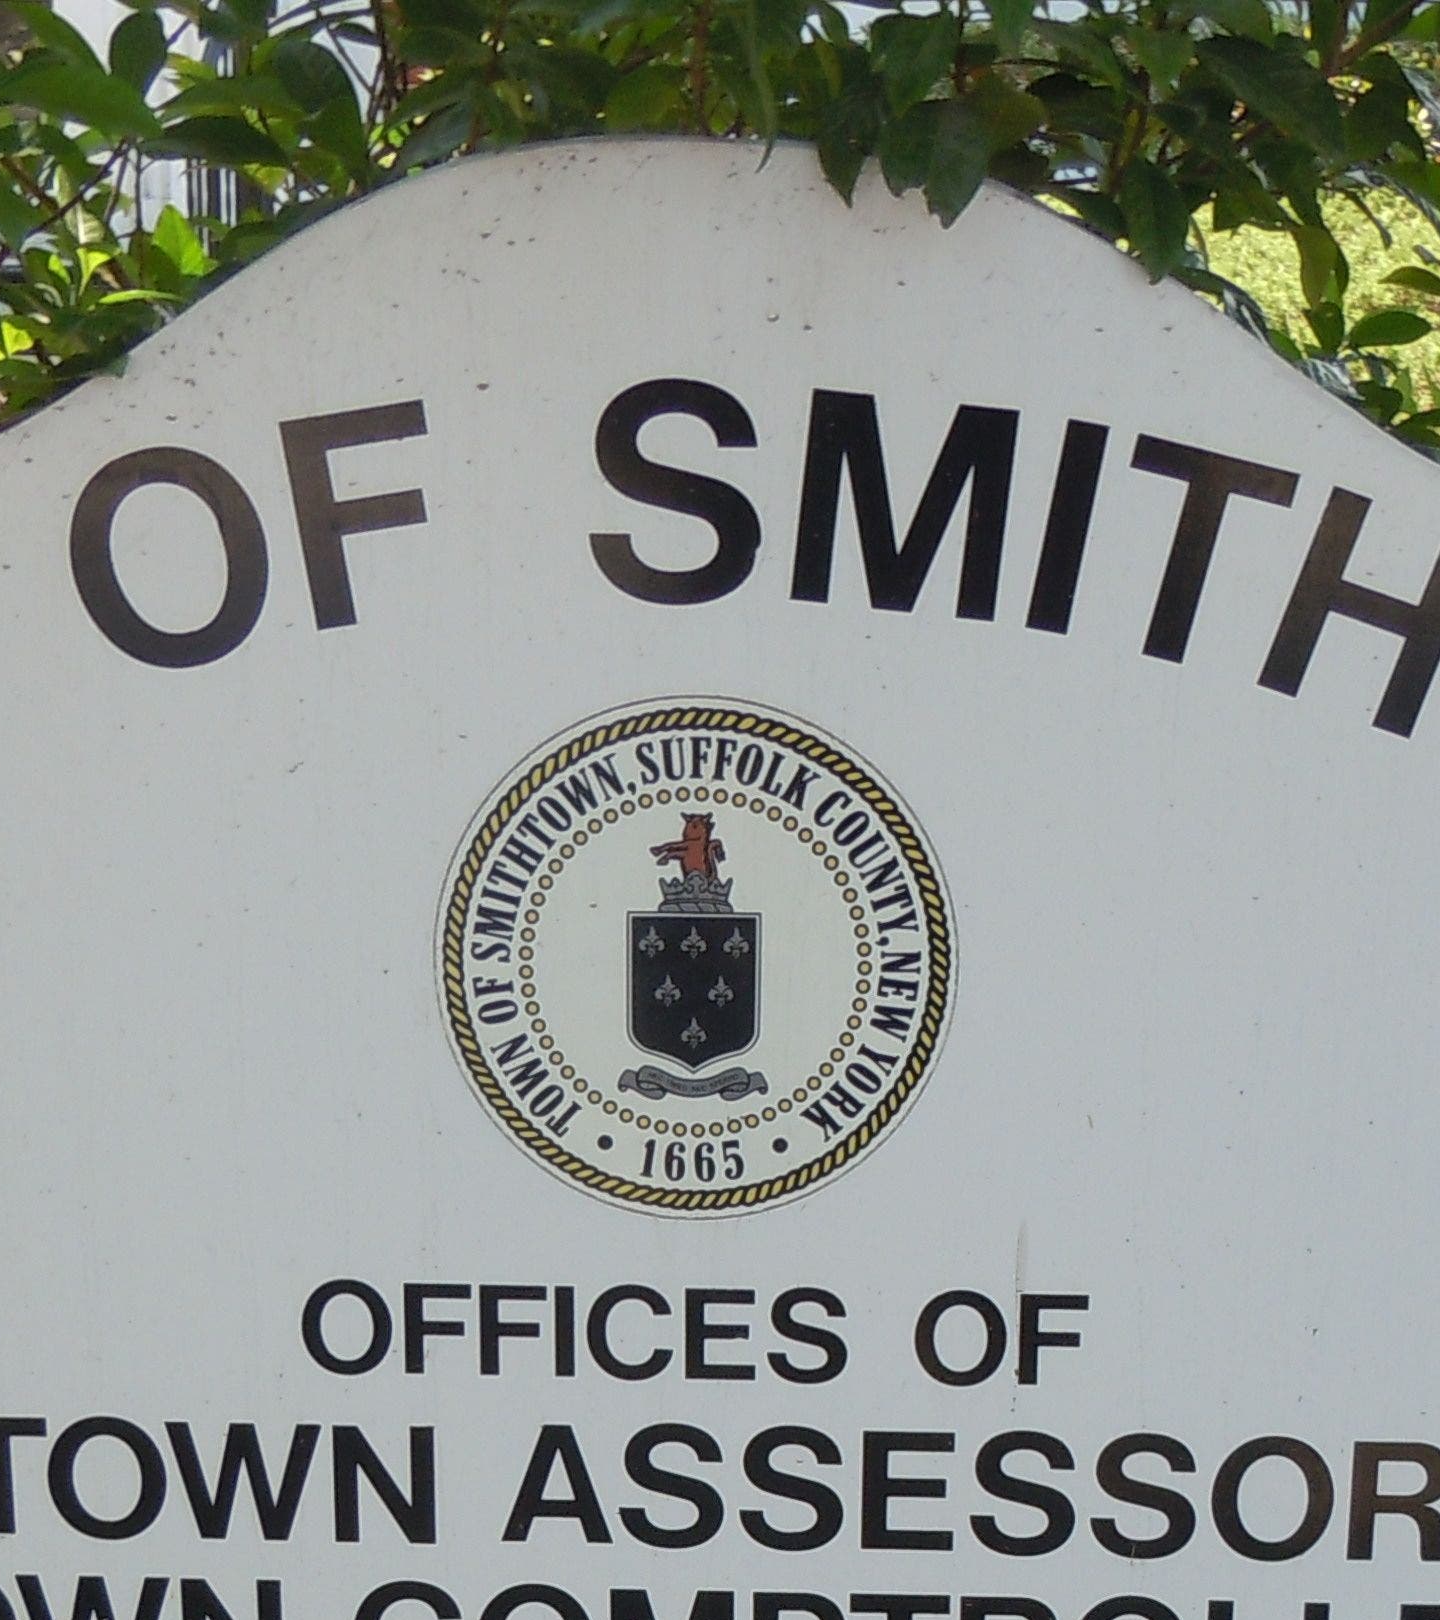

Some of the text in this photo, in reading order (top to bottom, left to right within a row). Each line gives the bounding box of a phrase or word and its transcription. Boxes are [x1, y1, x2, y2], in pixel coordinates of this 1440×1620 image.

[70, 400, 427, 668] OF
[636, 736, 820, 811] SUFFOLK
[472, 975, 517, 1024] OF
[870, 949, 922, 1043] NEW
[491, 1032, 582, 1138] TOWN
[800, 1043, 901, 1142] YORK
[640, 1140, 745, 1182] 1665
[302, 1279, 1089, 1386] OFFICES OF
